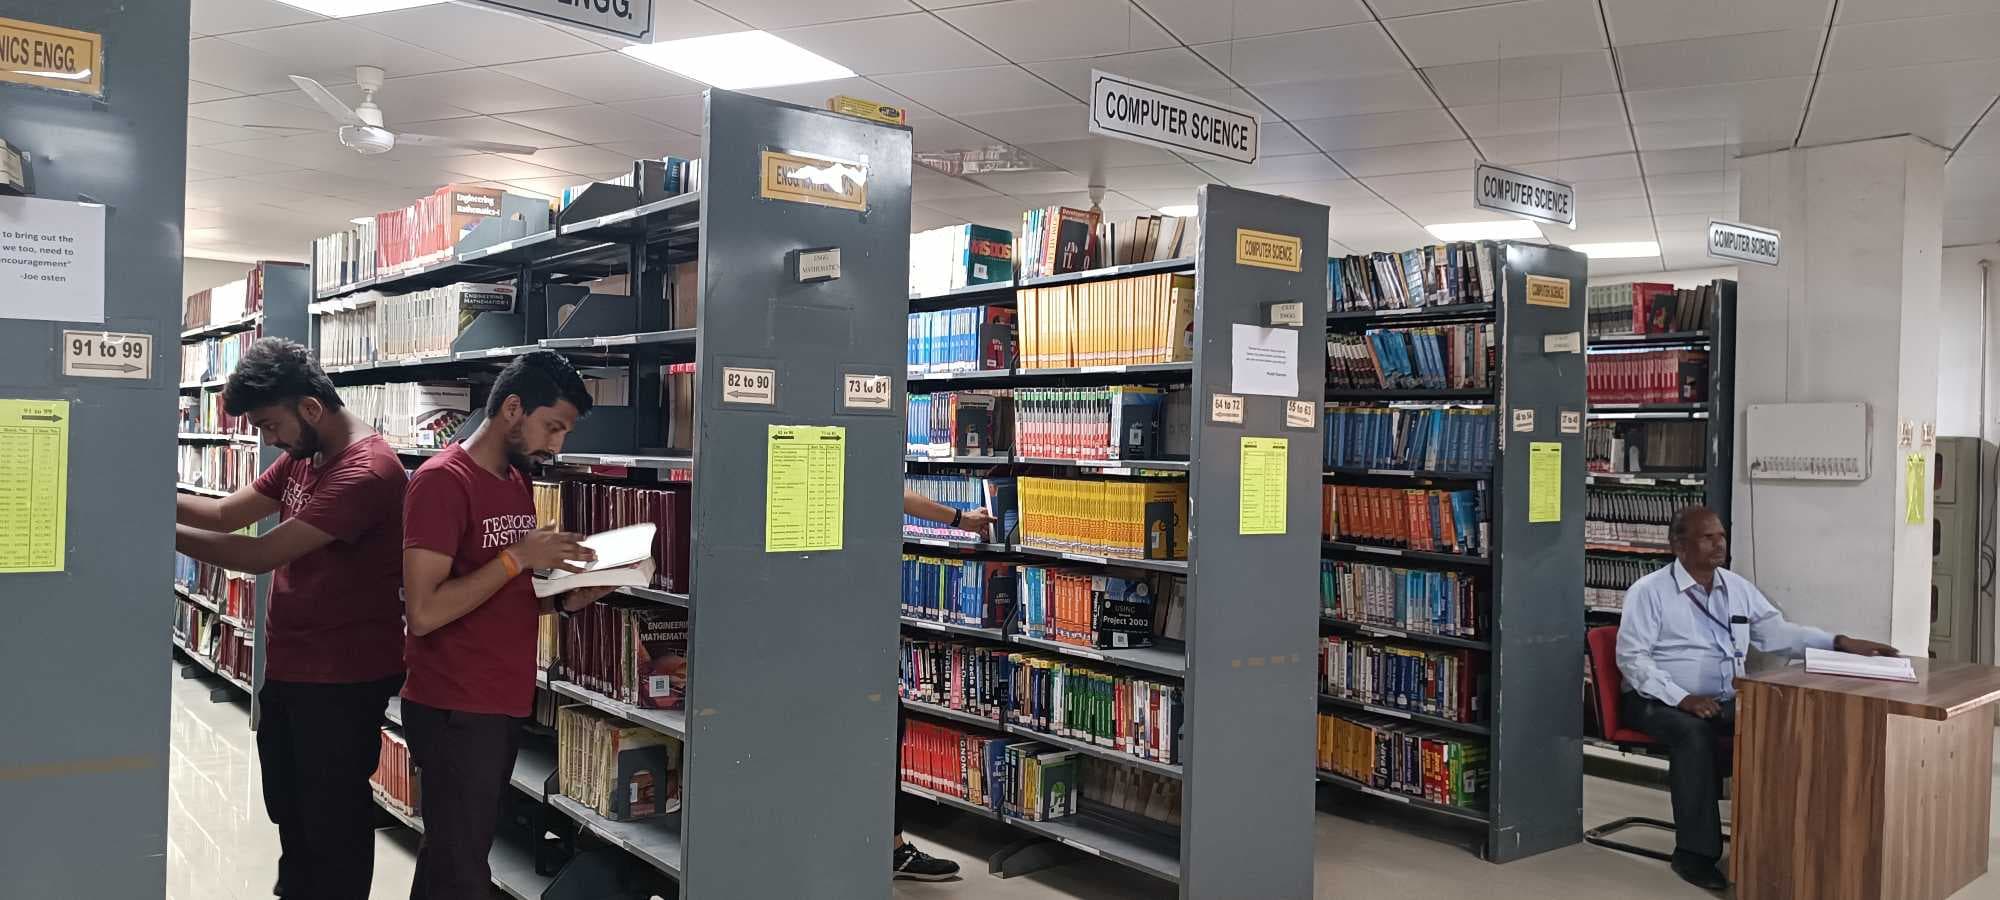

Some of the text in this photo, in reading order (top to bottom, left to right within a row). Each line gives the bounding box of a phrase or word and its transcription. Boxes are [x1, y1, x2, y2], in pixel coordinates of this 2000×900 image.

[1105, 91, 1248, 151] COMPUTER SCIENCE
[1483, 175, 1569, 214] COMPUTER SCIENCE
[2, 231, 13, 239] to
[15, 231, 39, 242] bring
[59, 234, 74, 243] the
[1713, 229, 1776, 258] COMPUTER SCIENCE
[39, 247, 62, 256] need
[64, 248, 75, 256] to
[1244, 240, 1293, 262] COMPUTER SCIENCE
[72, 338, 143, 359] 91 to 99
[728, 373, 769, 389] 82 to 90
[849, 380, 887, 394] 73 to 81
[1224, 400, 1231, 411] to
[1232, 401, 1240, 411] 72
[1288, 401, 1297, 412] 55
[1103, 615, 1127, 626] Project
[960, 740, 968, 780] GNOME
